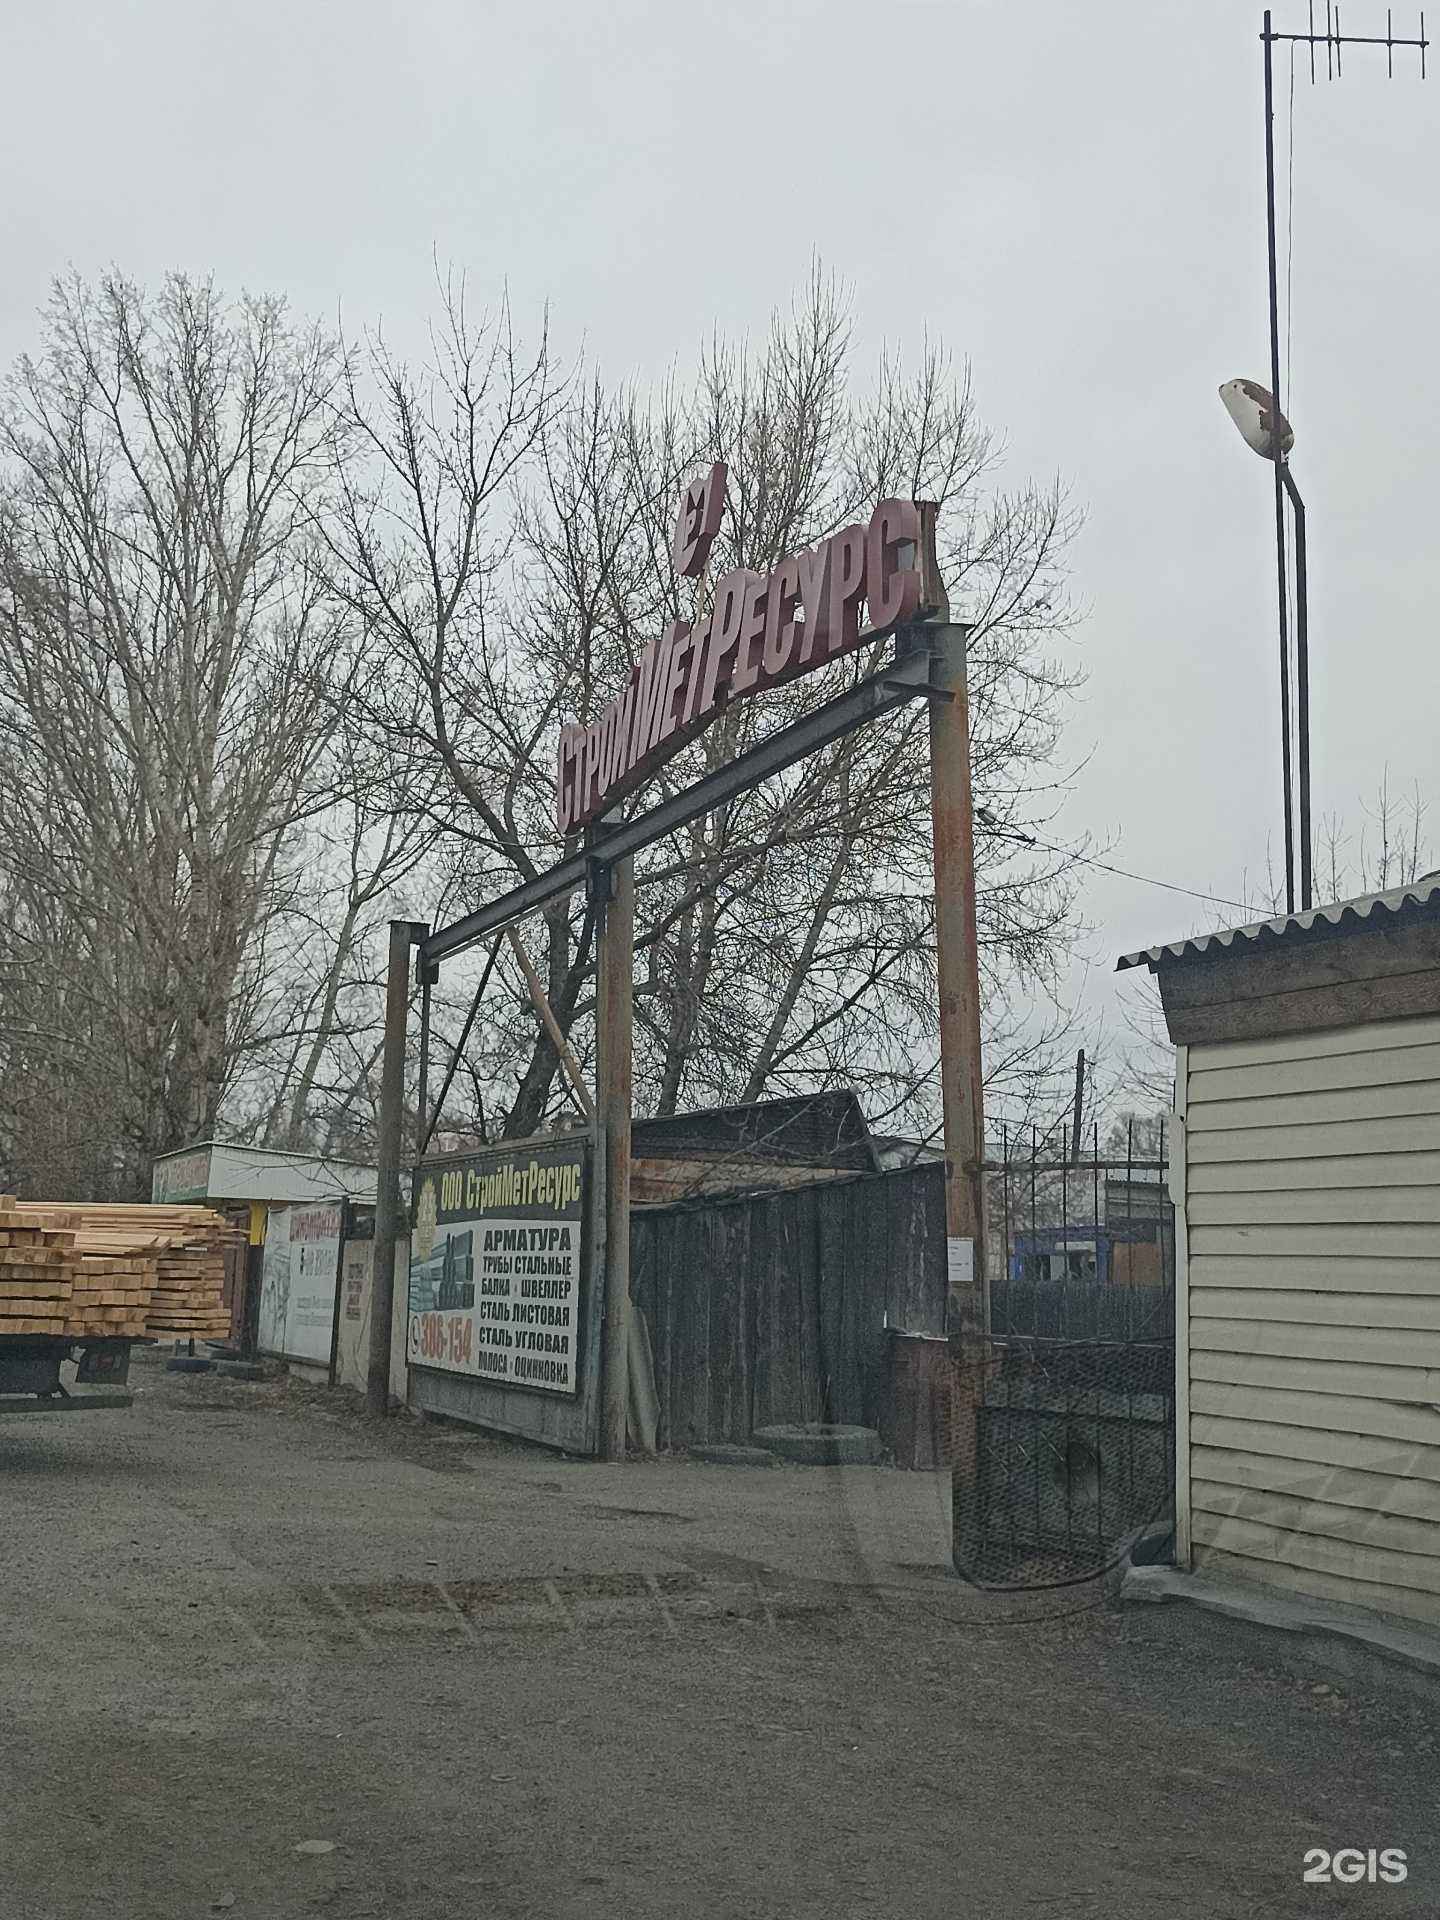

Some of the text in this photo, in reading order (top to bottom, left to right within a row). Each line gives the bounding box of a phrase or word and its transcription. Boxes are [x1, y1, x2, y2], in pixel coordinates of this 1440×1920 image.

[442, 1162, 580, 1214] ООО СтройМетРесурс
[483, 1227, 571, 1252] АРМАТУРА
[482, 1255, 571, 1275] ТРУБЫ СТАЛЬНЫЕ
[481, 1278, 571, 1299] БАЛКА ШВЕЛЛЕР
[480, 1301, 570, 1327] СТАЛЬ ЛИСТОВАЯ
[479, 1326, 569, 1354] СТАЛЬ УГЛОВАЯ
[478, 1350, 569, 1385] ПОЛОСА ОЦИНКОВКА
